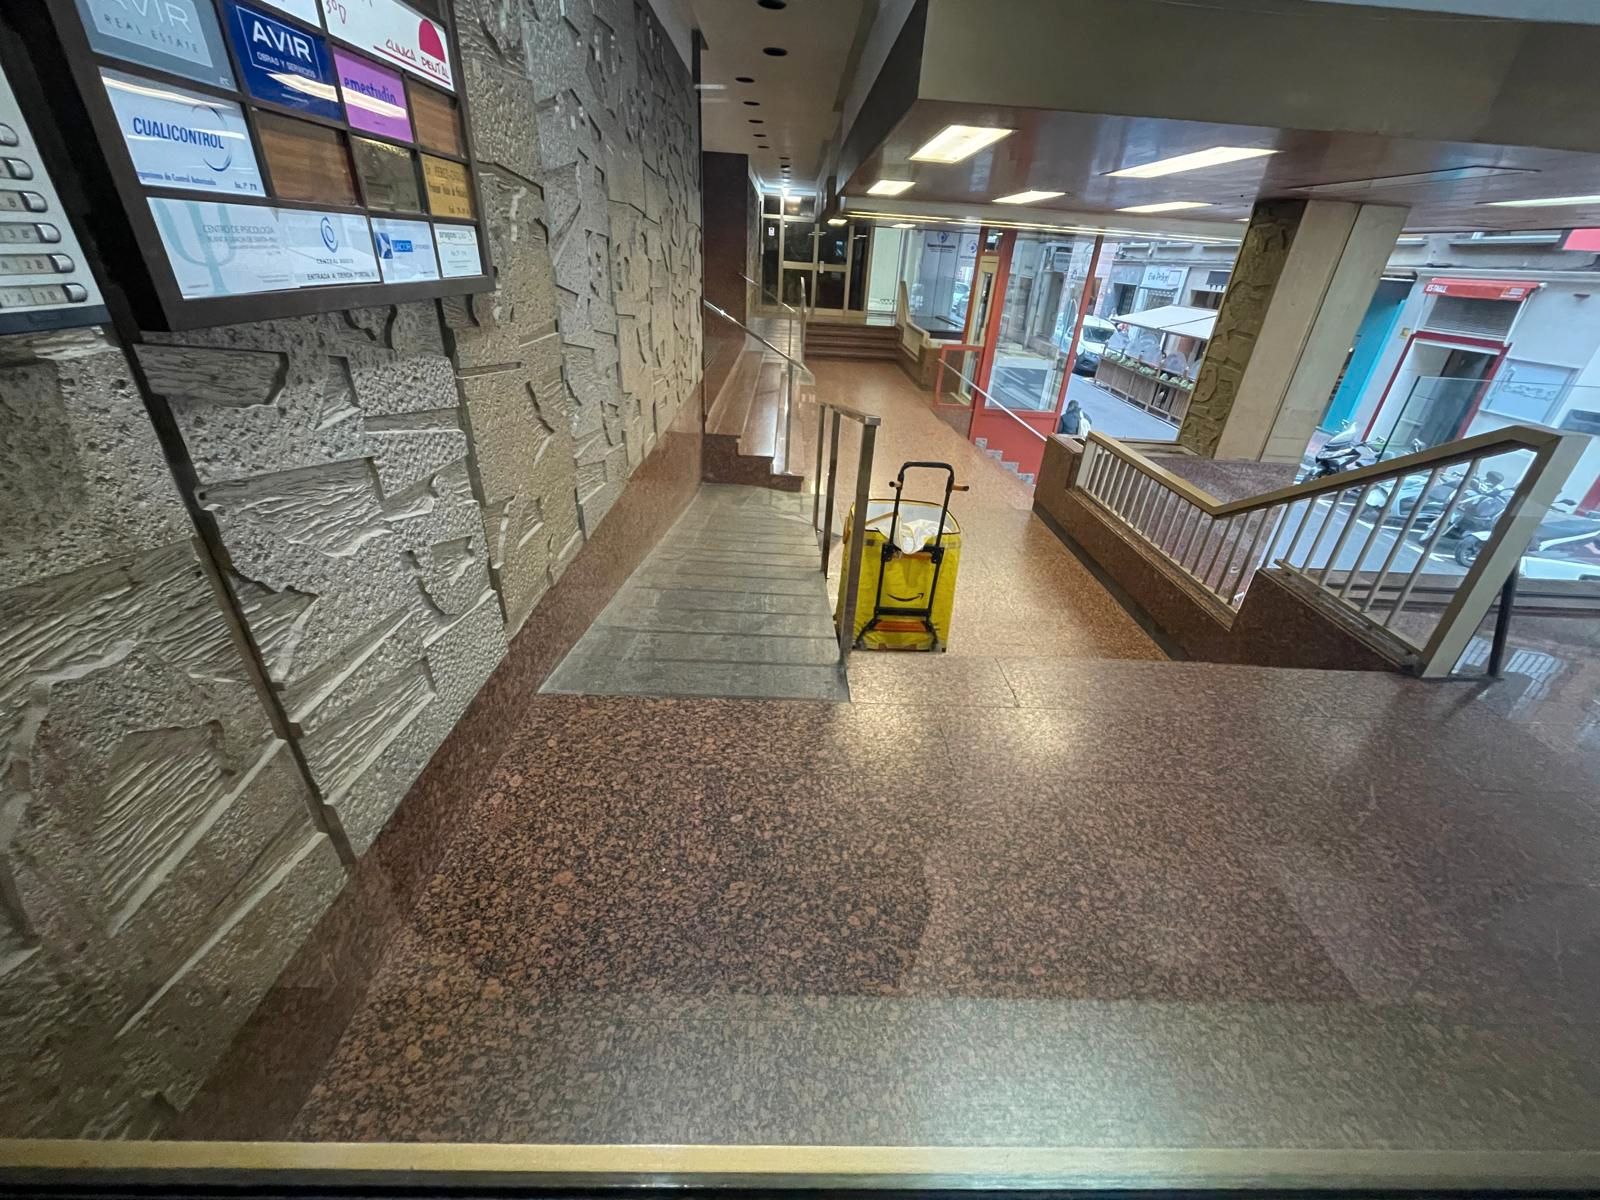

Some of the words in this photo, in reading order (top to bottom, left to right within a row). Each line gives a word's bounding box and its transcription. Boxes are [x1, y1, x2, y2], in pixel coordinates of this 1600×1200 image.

[104, 13, 143, 36] REAL
[151, 29, 199, 53] ESTATE
[253, 20, 312, 63] AVIR
[420, 55, 450, 79] DENTAL
[133, 117, 225, 149] CUALICONTROL
[202, 224, 231, 234] CENTRO
[231, 224, 240, 234] DE
